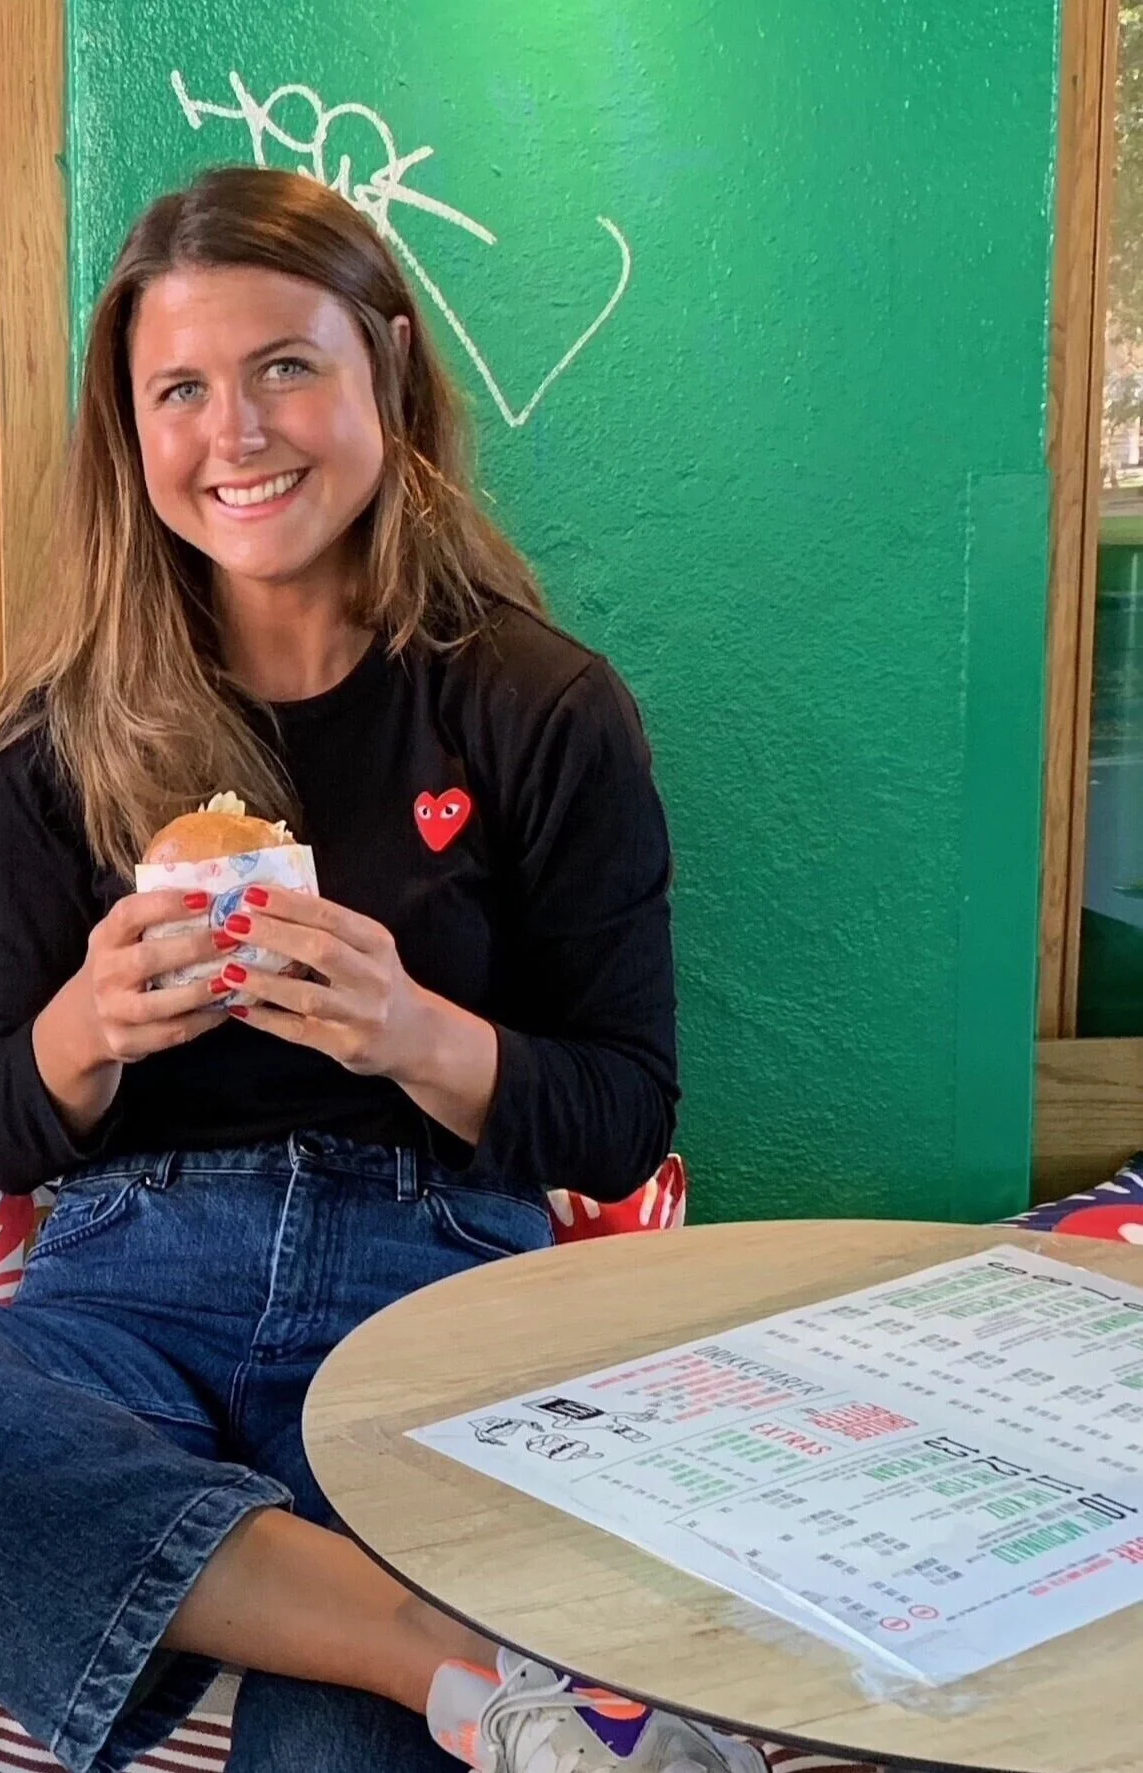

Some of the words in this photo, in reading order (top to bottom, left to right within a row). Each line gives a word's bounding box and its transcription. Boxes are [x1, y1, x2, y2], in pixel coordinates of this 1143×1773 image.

[693, 1344, 825, 1396] DRIKKEVARER
[750, 1421, 833, 1456] EXTRAS
[923, 1436, 980, 1458] 13
[972, 1455, 1032, 1477] 12
[1026, 1474, 1085, 1495] 11
[1077, 1493, 1138, 1520] 10
